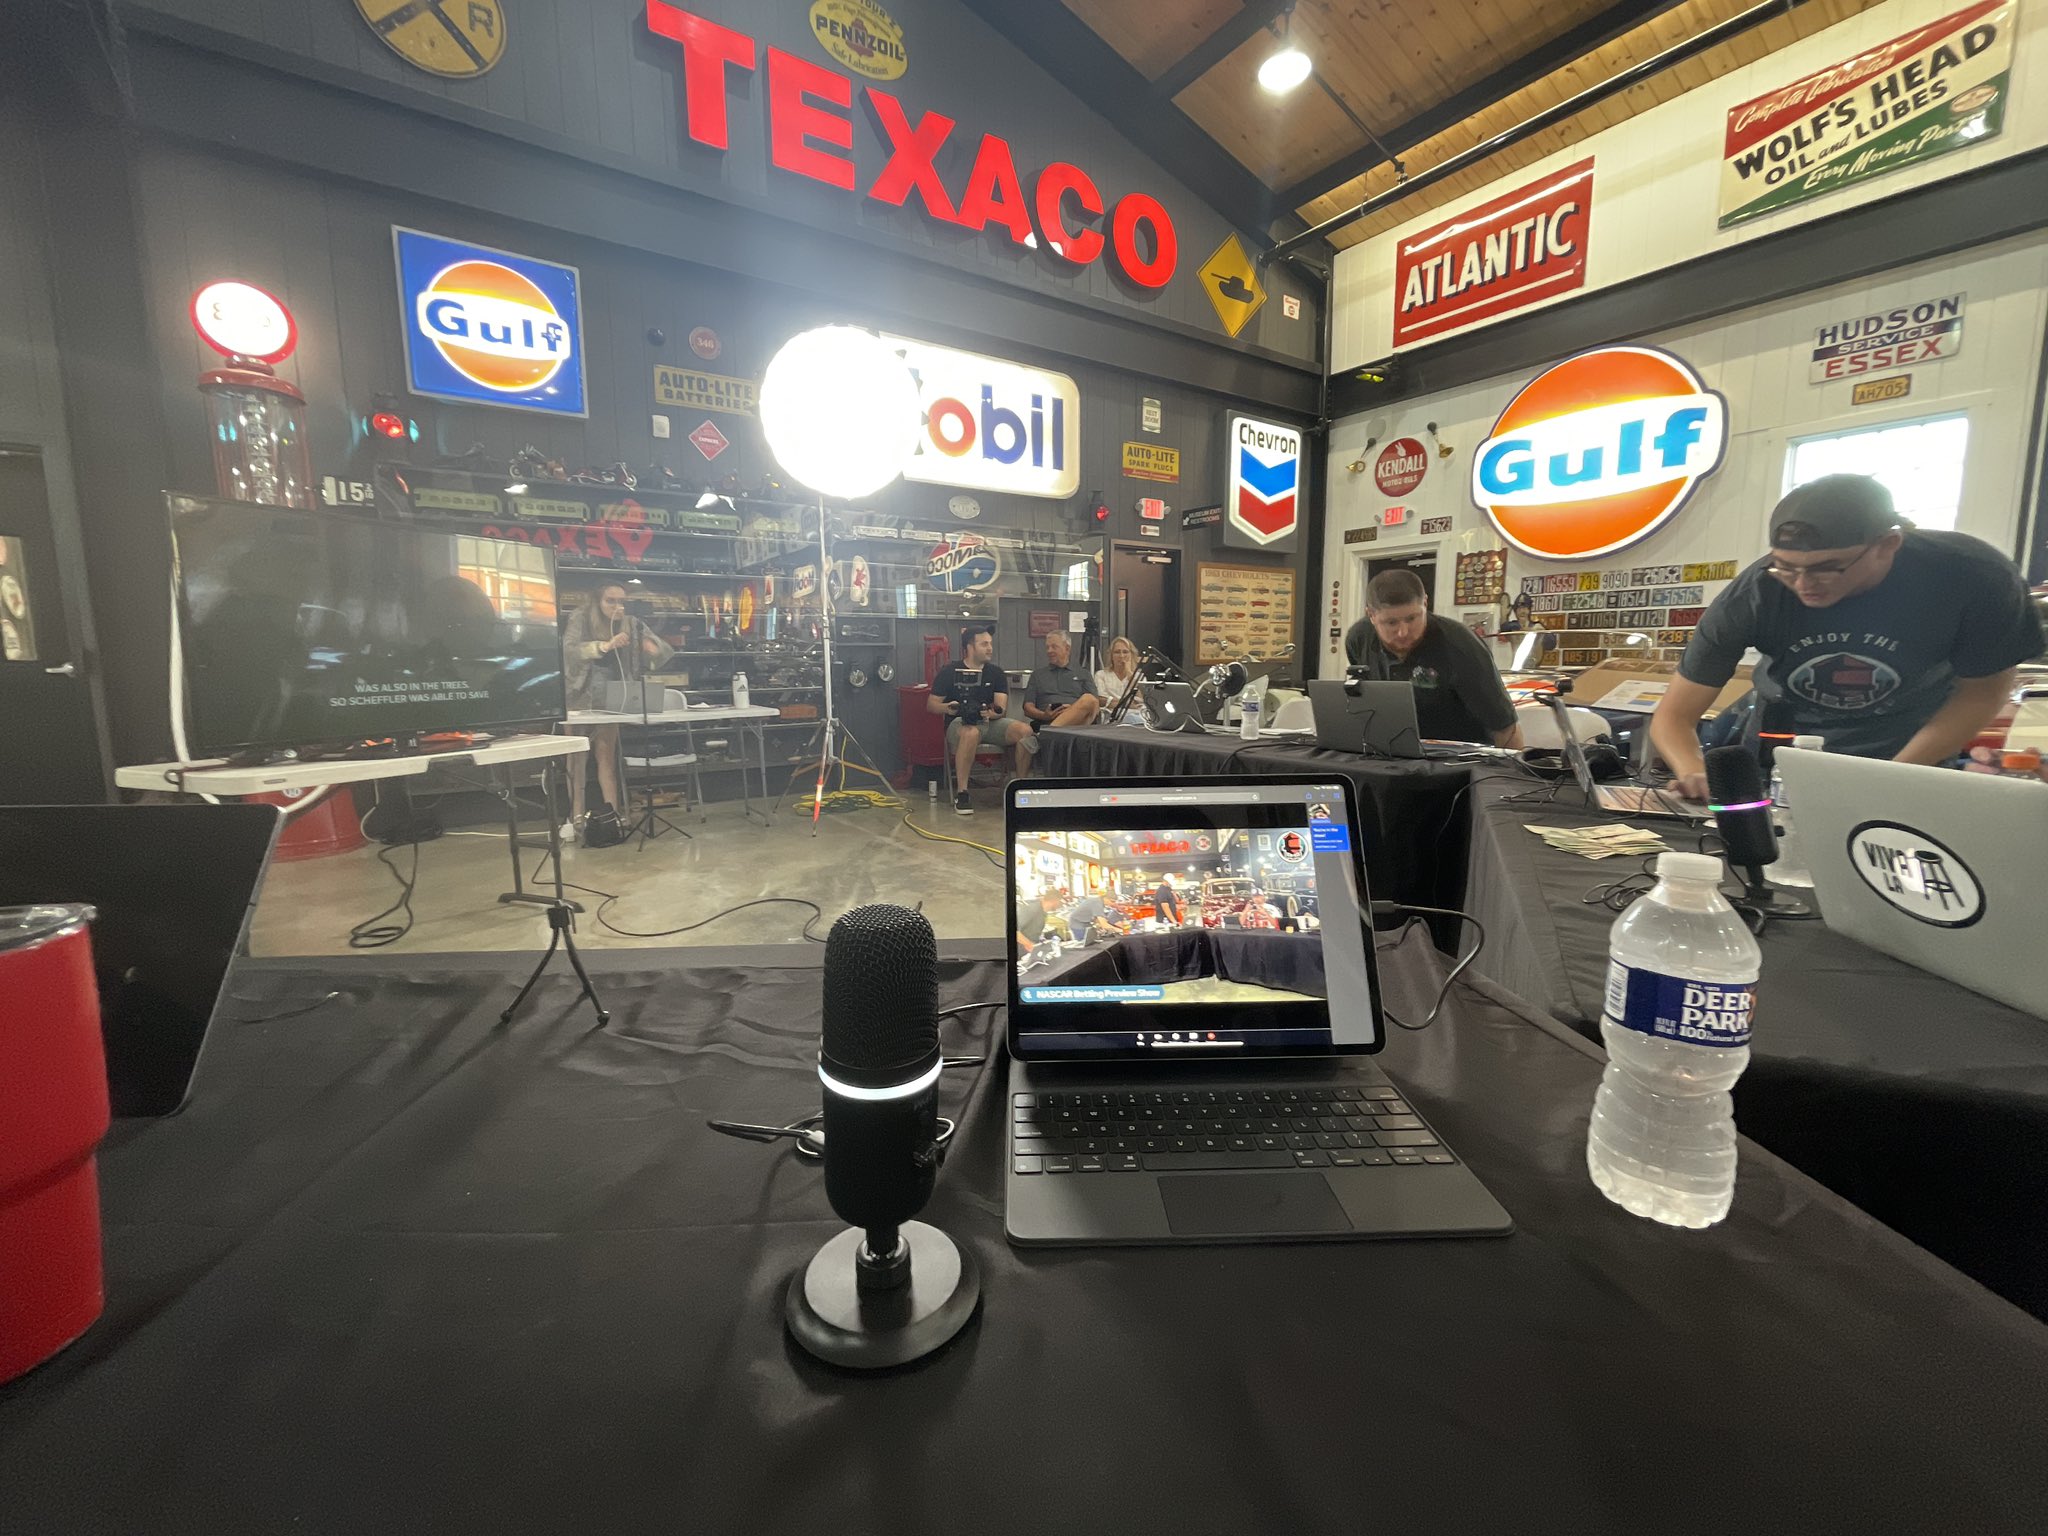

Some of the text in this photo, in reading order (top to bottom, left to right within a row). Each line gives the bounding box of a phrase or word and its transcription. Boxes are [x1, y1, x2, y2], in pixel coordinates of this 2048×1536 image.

[468, 1, 494, 38] R
[815, 13, 904, 62] PENNZOIL
[1733, 23, 1997, 180] WOLF'S HEAD
[646, 0, 1178, 288] TEXACO
[1764, 154, 1815, 186] OIL
[1817, 133, 1851, 160] and
[1855, 78, 1949, 141] LUBES
[1802, 162, 1850, 190] Every
[1847, 140, 1914, 177] Moving
[1401, 201, 1580, 313] ATLANTIC
[425, 298, 563, 353] Gulf
[1818, 295, 1960, 347] HUDSON
[1837, 324, 1935, 355] SERVICE
[1825, 336, 1943, 379] ESSEX
[660, 371, 753, 400] AUTO-LITE
[663, 388, 755, 412] BATTERIES
[912, 372, 1064, 471] obil
[1239, 422, 1298, 456] Chevron
[1479, 406, 1708, 495] Gulf
[1126, 446, 1176, 465] AUTO-LITE
[1128, 459, 1150, 469] SPARK
[1377, 453, 1425, 479] KENDALL
[338, 480, 365, 502] 15
[1385, 507, 1405, 526] EXIT
[1580, 574, 1600, 591] 739
[1789, 632, 1900, 653] ENJOY THE
[329, 690, 490, 707] SO SCHEFFLER WAS ABLE TO SAVE
[354, 680, 470, 693] WAS ALSO IN THE TREES.
[1861, 840, 1914, 878] VIVA
[1882, 871, 1905, 895] LA
[1036, 990, 1073, 999] NASCAR
[1682, 987, 1751, 1011] DEER
[1680, 1006, 1751, 1033] PARK
